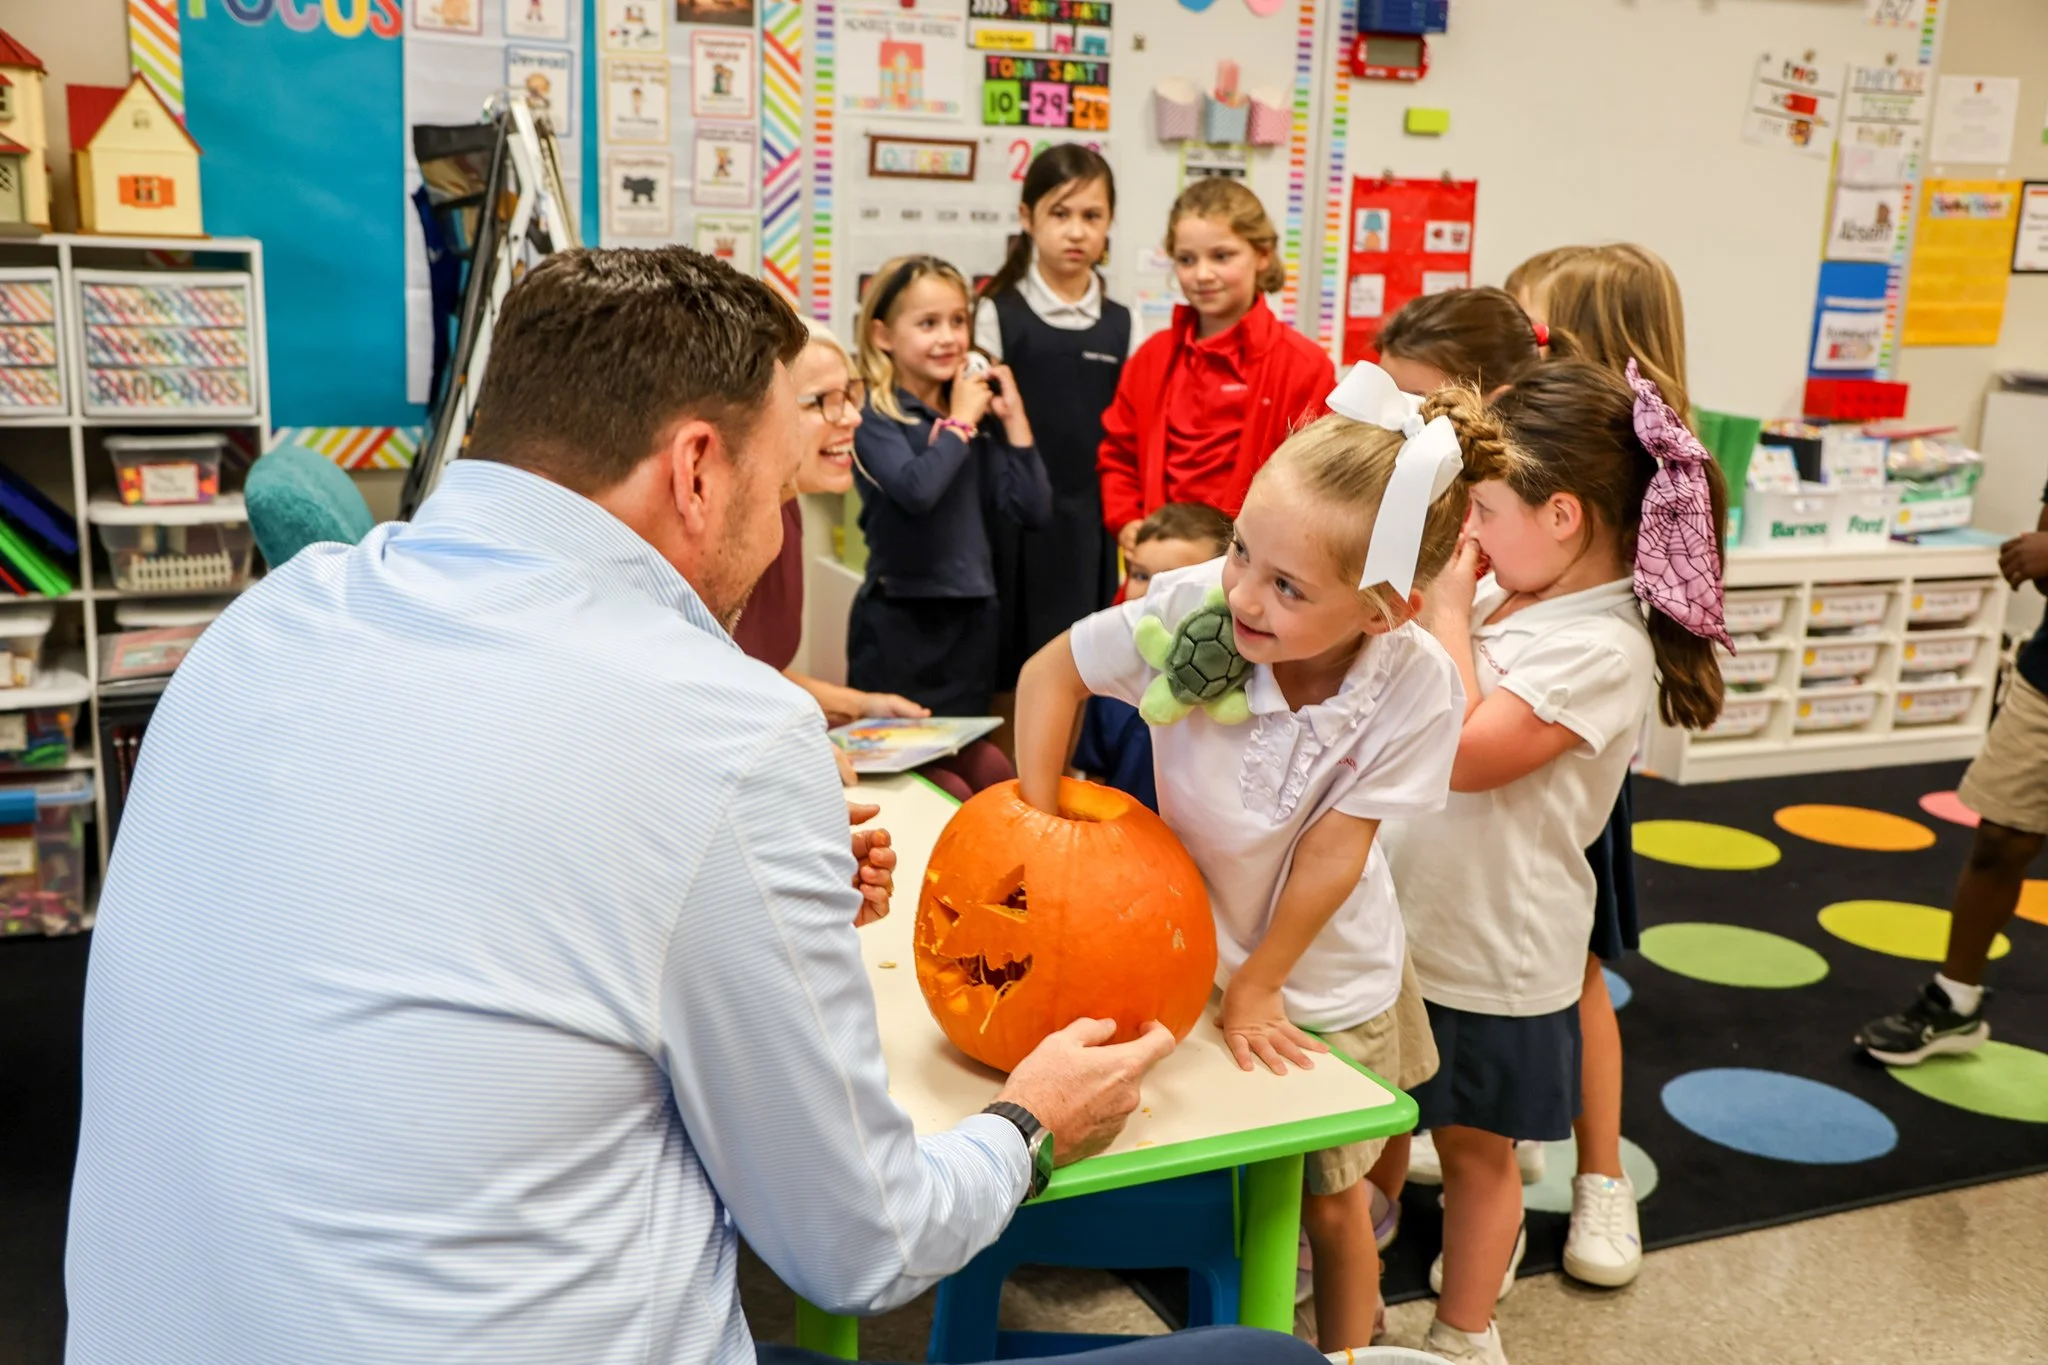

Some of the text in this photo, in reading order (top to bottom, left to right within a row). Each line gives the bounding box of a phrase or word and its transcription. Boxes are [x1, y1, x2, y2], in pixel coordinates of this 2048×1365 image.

[990, 91, 1013, 114] 10
[1035, 92, 1064, 116] 29
[1771, 514, 1885, 539] Barnes Ford
